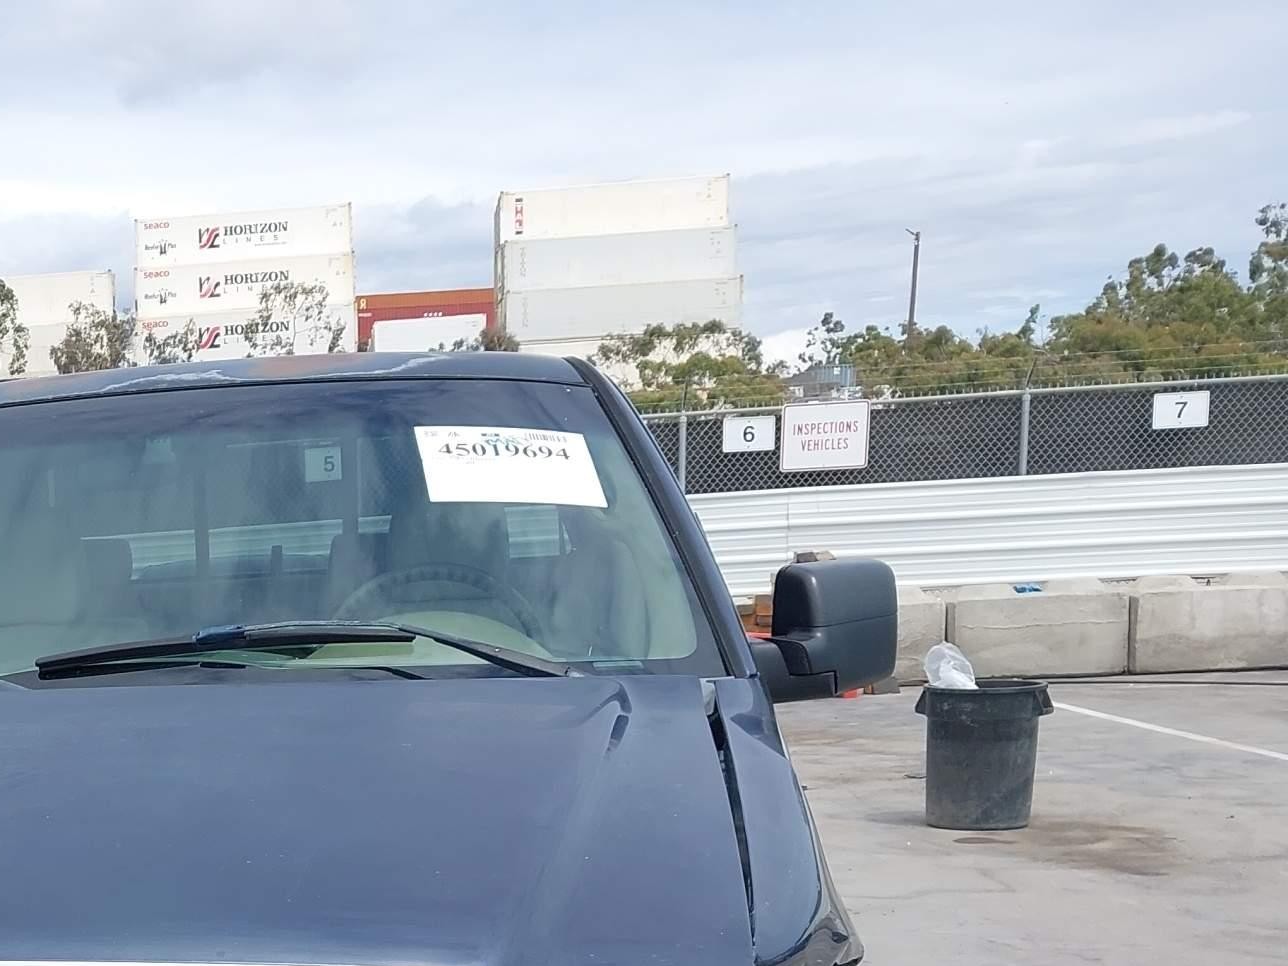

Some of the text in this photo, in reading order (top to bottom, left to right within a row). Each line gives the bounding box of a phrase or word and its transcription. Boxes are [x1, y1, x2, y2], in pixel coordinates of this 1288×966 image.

[143, 221, 170, 230] seaco
[223, 221, 289, 237] HORIZON
[143, 270, 170, 280] seaco
[224, 270, 290, 286] HORIZON
[224, 320, 290, 336] HORIZON
[1174, 401, 1188, 419] 7
[743, 425, 755, 443] 6
[792, 420, 859, 436] INSPECTIONS
[438, 442, 570, 460] 45019694
[800, 437, 849, 452] VEHICLES
[323, 455, 335, 473] 5
